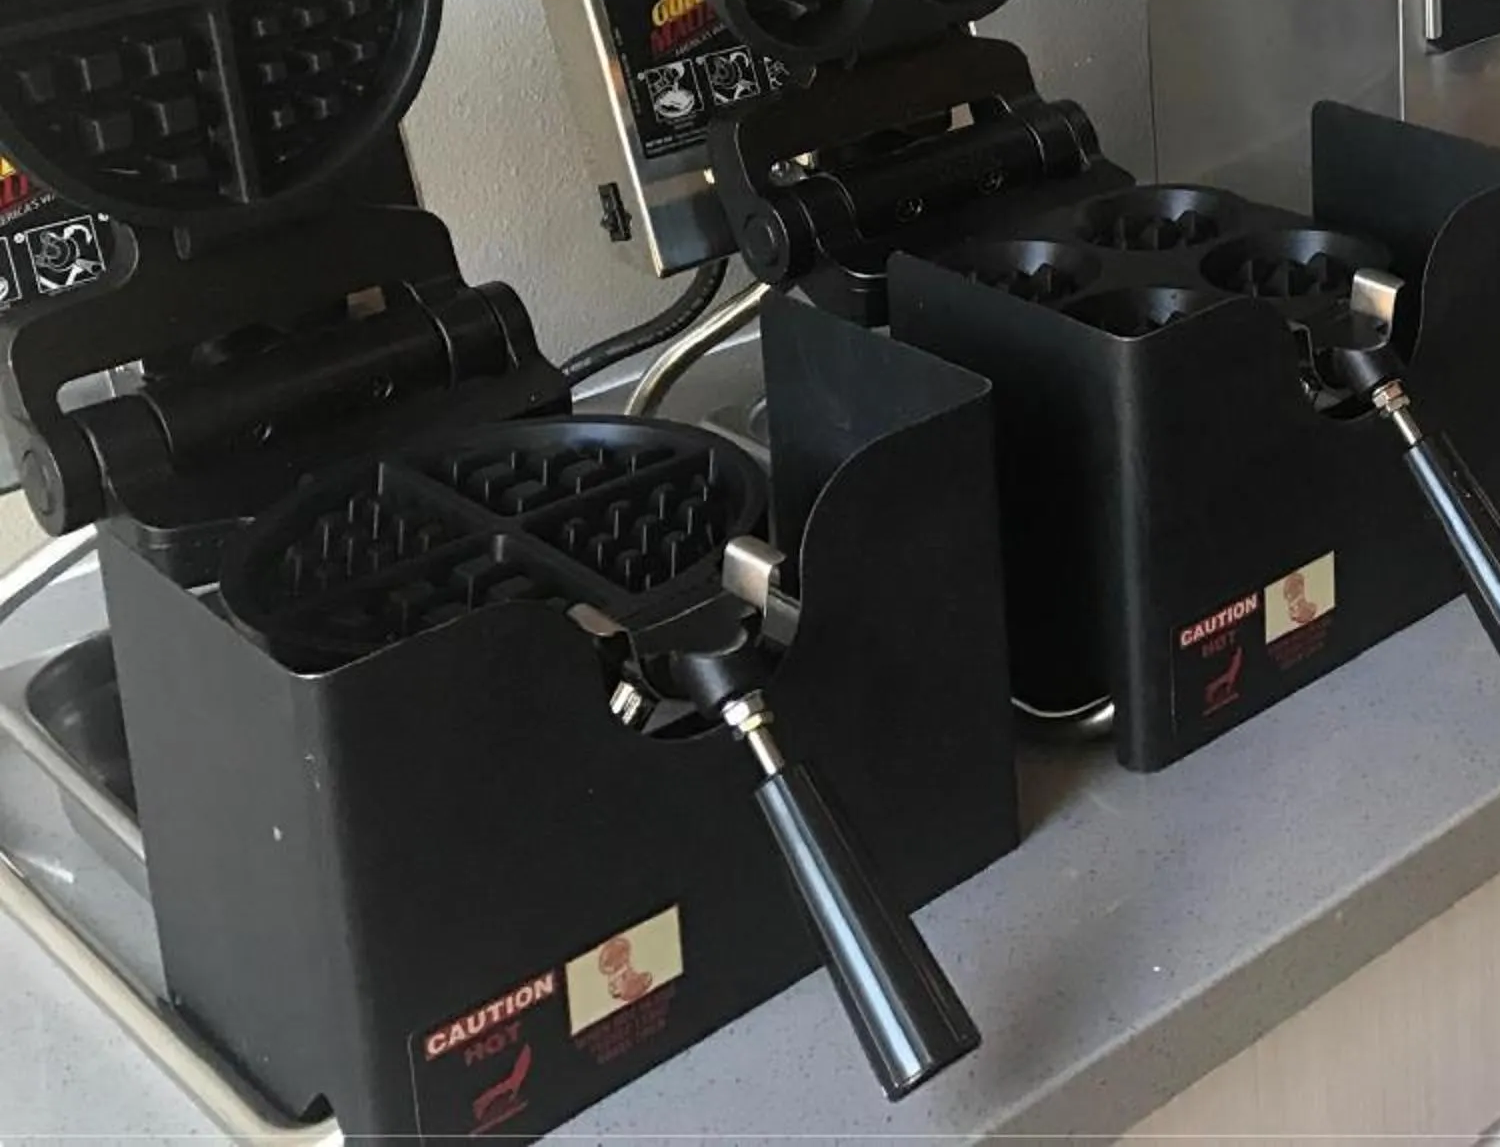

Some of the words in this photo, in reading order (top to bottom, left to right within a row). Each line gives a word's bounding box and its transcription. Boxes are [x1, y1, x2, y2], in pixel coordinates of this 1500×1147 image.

[1180, 593, 1258, 648] CAUTION
[426, 971, 554, 1056] CAUTION
[464, 1021, 521, 1067] HOT
